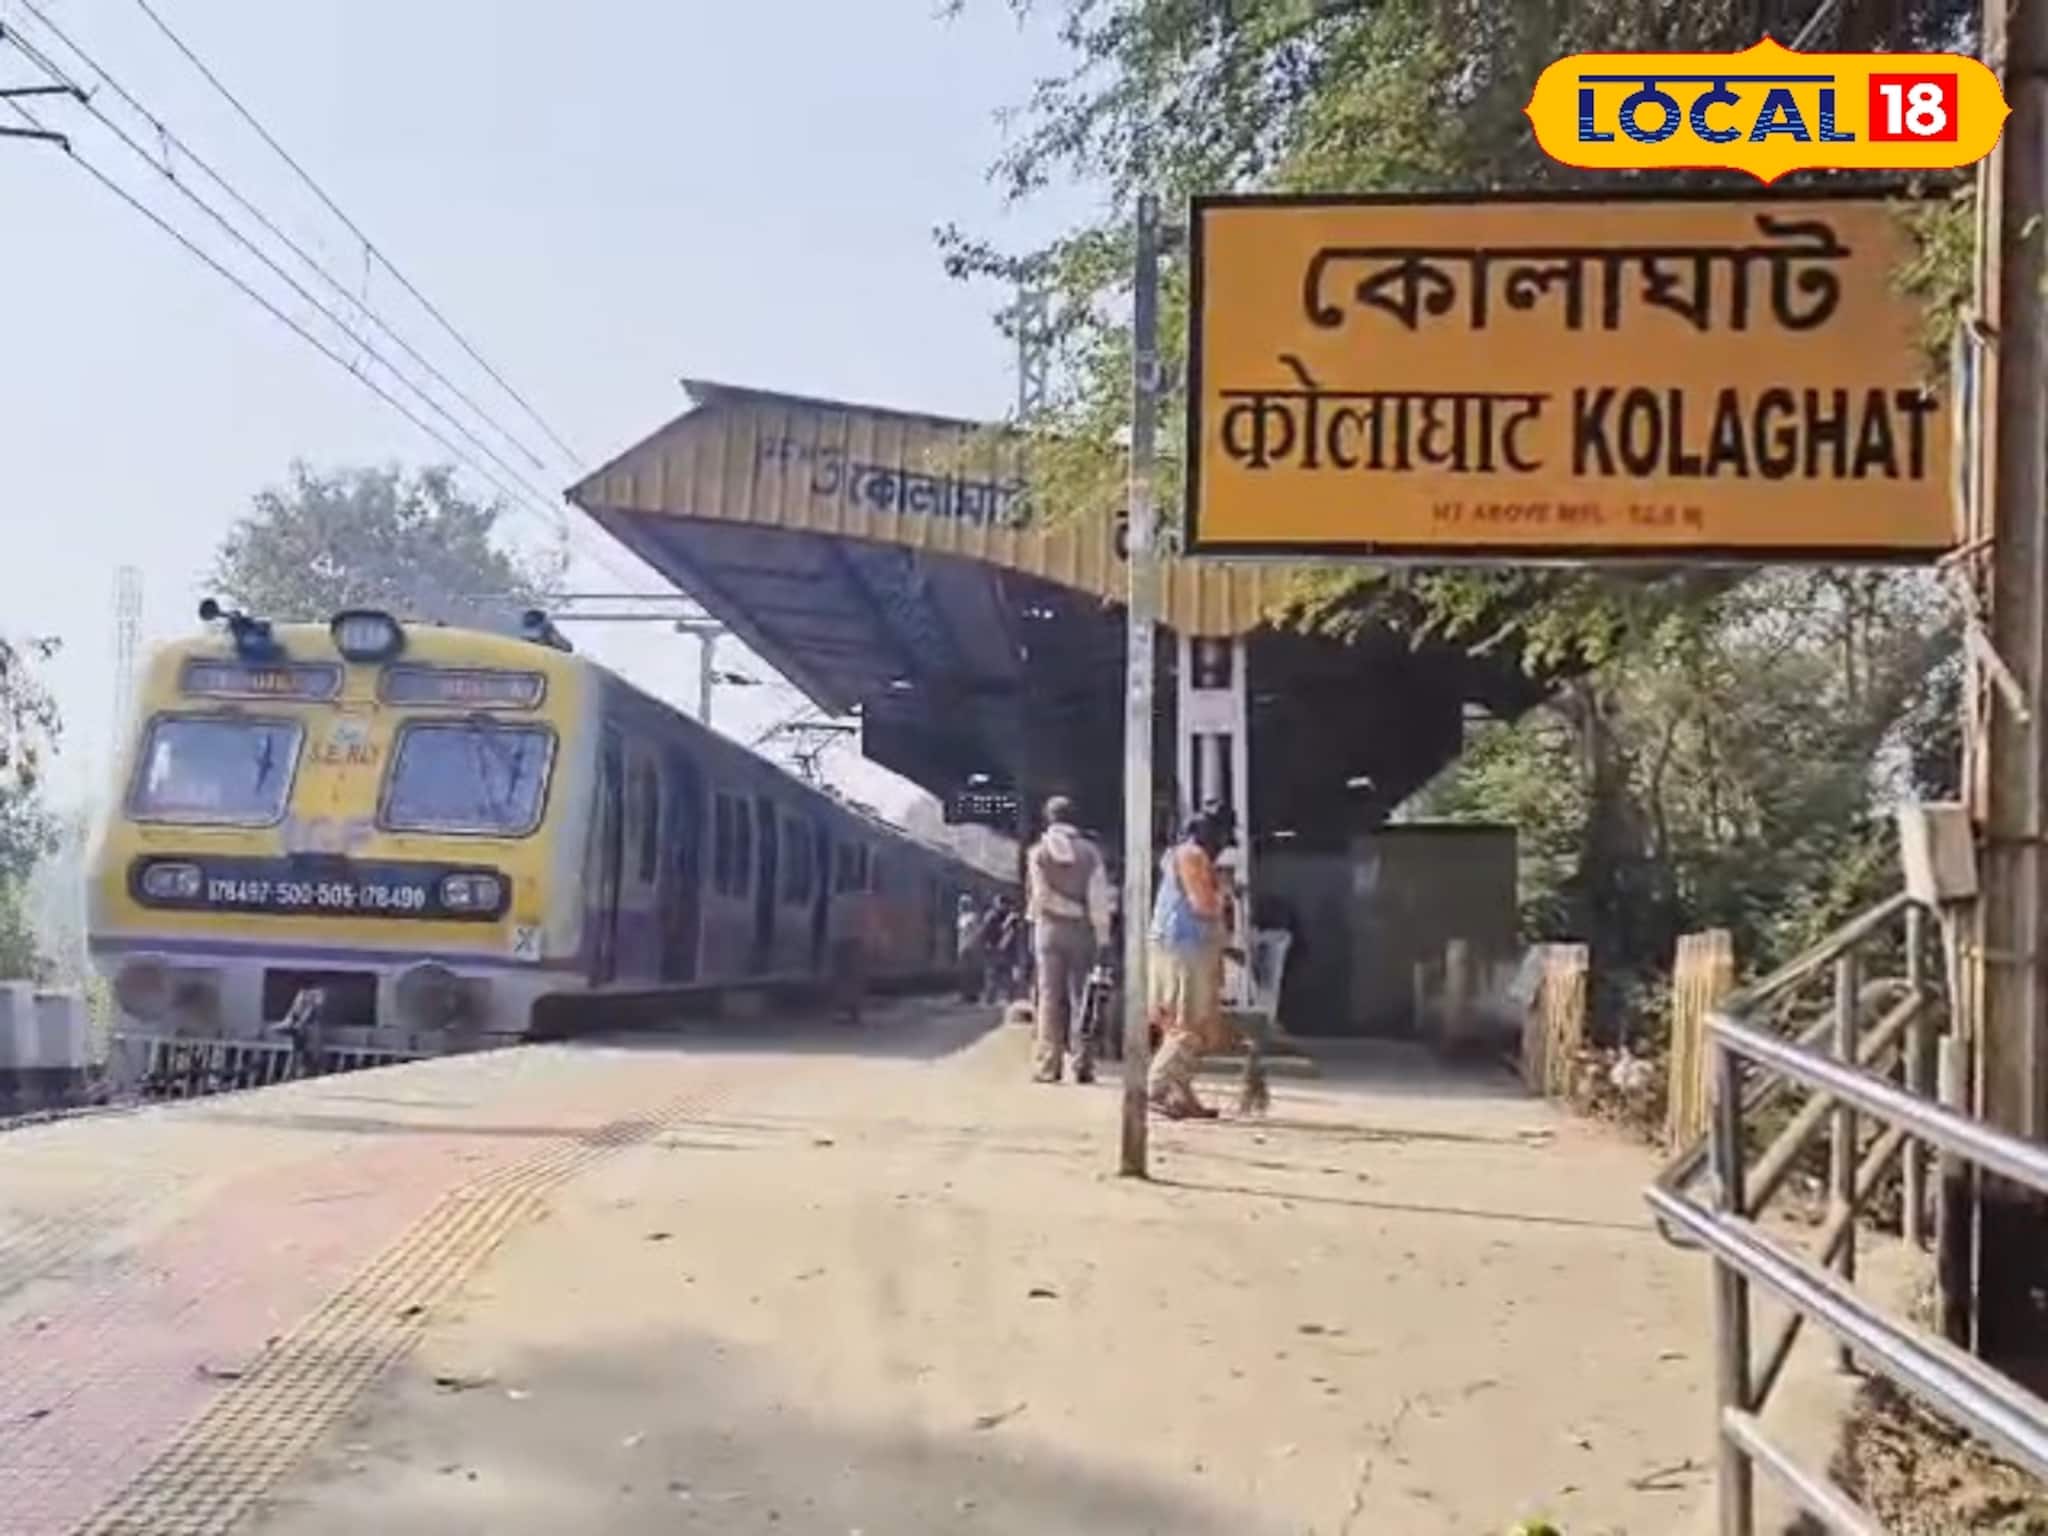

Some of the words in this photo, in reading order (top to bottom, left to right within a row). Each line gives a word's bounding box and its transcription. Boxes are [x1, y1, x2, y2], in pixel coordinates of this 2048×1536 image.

[1302, 213, 1851, 332] কোলাঘাট
[1218, 354, 1553, 475] कोलाघाट
[1572, 386, 1940, 481] KOLAGHAT
